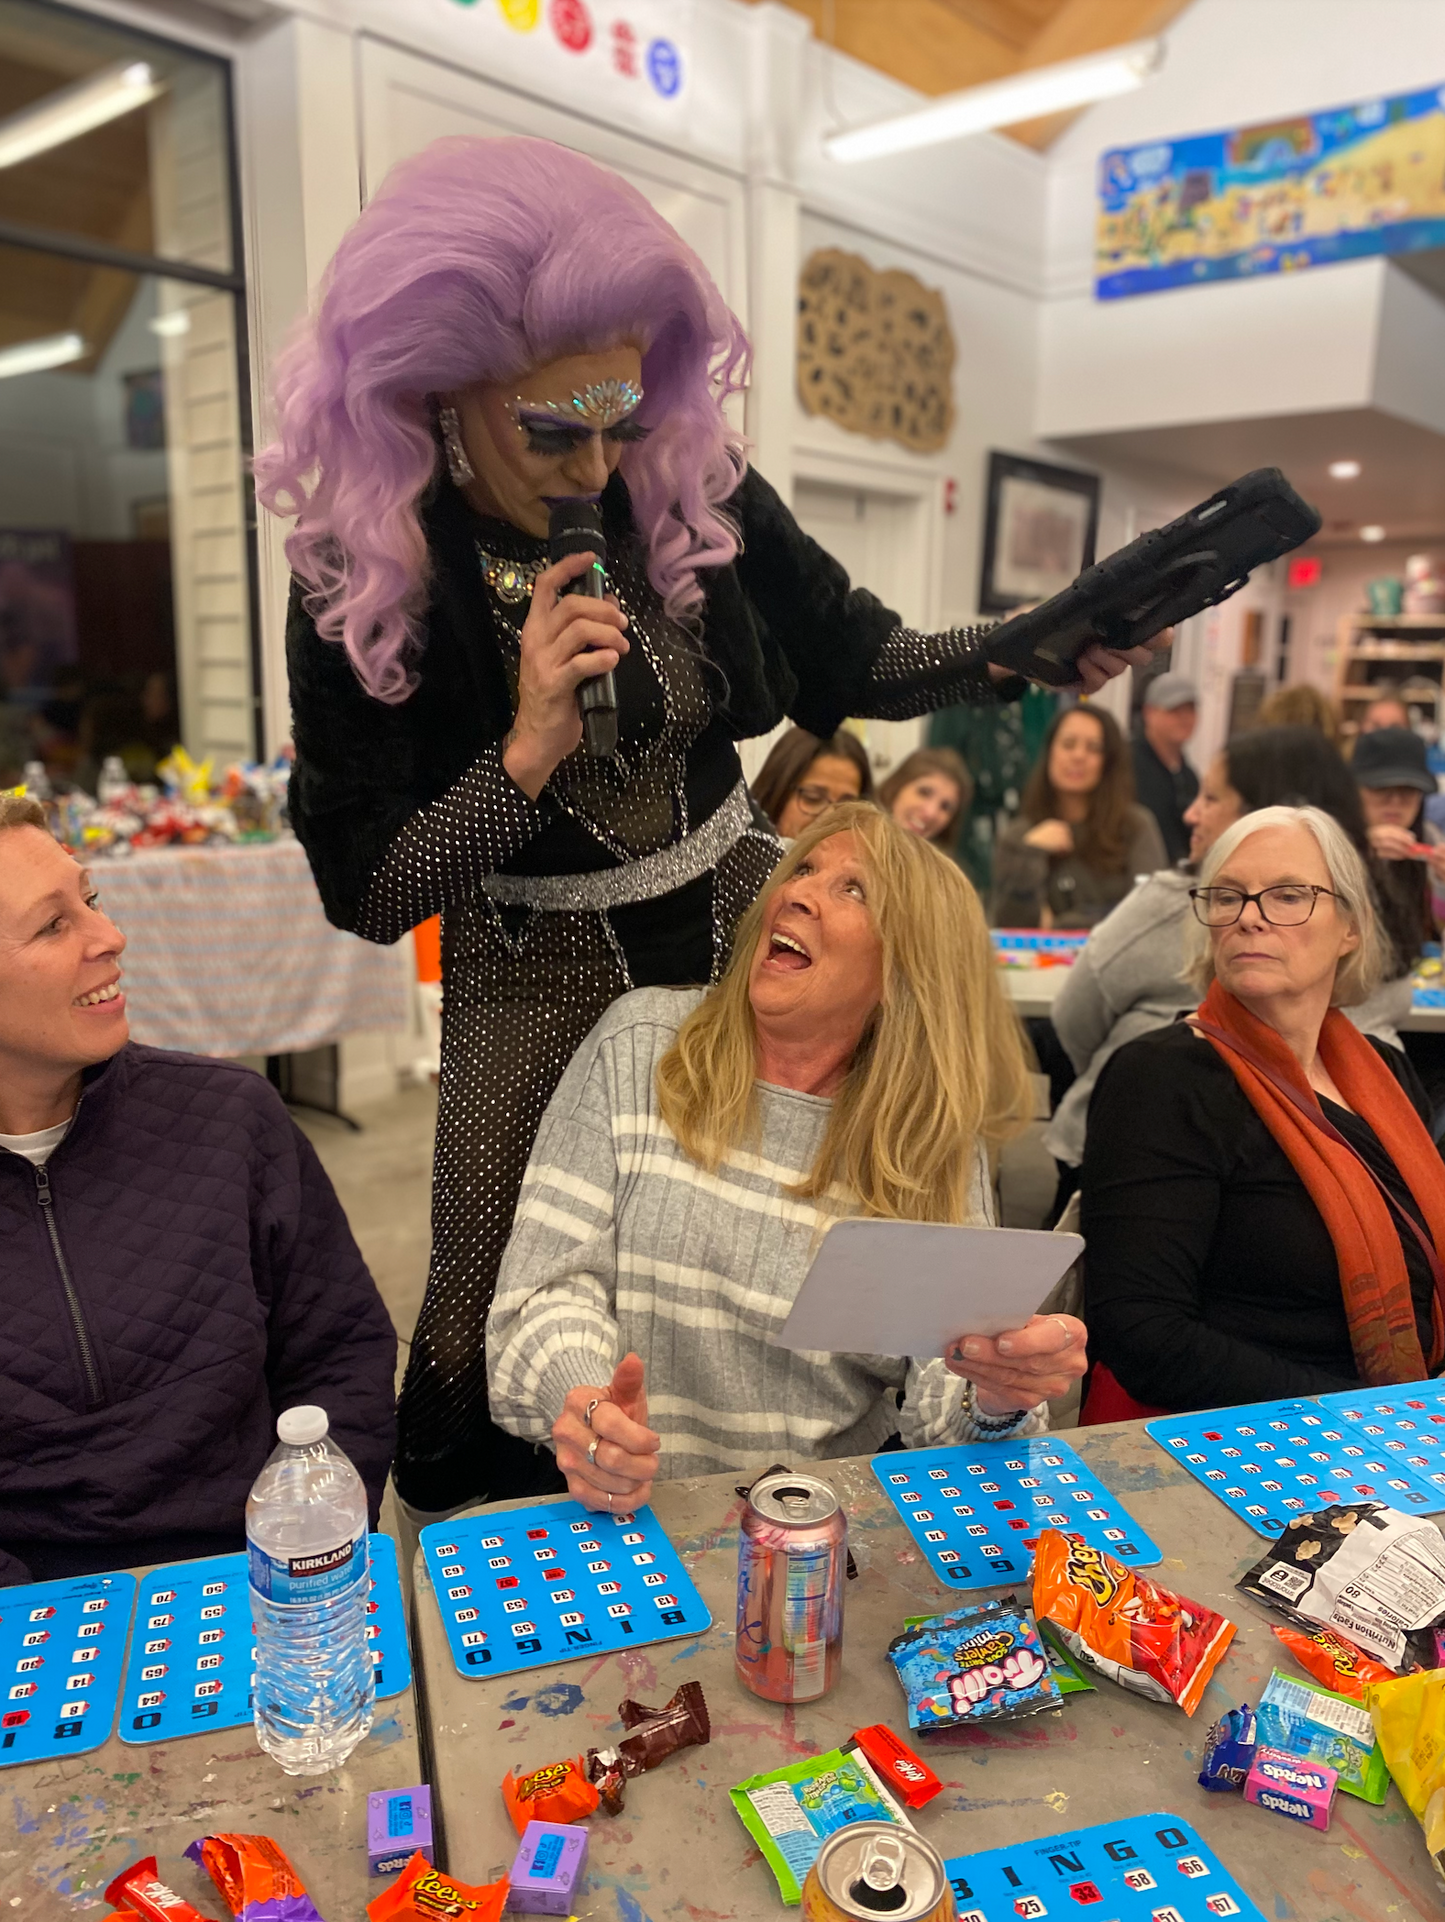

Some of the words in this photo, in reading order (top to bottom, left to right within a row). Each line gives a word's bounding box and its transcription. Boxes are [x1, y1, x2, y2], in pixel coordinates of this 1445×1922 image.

[892, 1476, 906, 1484] 69
[942, 1489, 958, 1497] 53
[982, 1484, 998, 1492] 35
[904, 1494, 918, 1502] 65
[956, 1507, 970, 1515] 46
[916, 1512, 929, 1521] 67
[528, 1530, 543, 1538] 33
[969, 1526, 984, 1535] 50
[929, 1532, 943, 1540] 74
[485, 1538, 498, 1547] 51
[580, 1542, 596, 1551] 26
[438, 1546, 453, 1555] 66
[536, 1550, 551, 1559] 44
[983, 1546, 999, 1555] 52
[1114, 1543, 1141, 1556] B
[292, 1544, 352, 1571] KIRKLAND
[941, 1552, 957, 1561] 64
[490, 1558, 506, 1567] 60
[592, 1562, 605, 1571] 27
[990, 1560, 1015, 1573] G
[444, 1566, 460, 1576] 63
[946, 1566, 973, 1580] O
[290, 1576, 329, 1591] purified
[331, 1564, 354, 1580] water
[648, 1575, 660, 1584] 12
[500, 1579, 514, 1588] 57
[601, 1584, 616, 1593] 16
[206, 1586, 223, 1595] 50
[451, 1588, 467, 1598] 68
[1345, 1586, 1361, 1599] 80
[156, 1594, 170, 1603] 70
[554, 1591, 570, 1601] 34
[658, 1596, 672, 1606] 13
[89, 1603, 103, 1611] 15
[506, 1600, 523, 1611] 53
[611, 1605, 626, 1615] 21
[204, 1608, 221, 1618] 55
[458, 1610, 474, 1621] 69
[660, 1610, 687, 1626] B
[1378, 1606, 1410, 1630] Calories
[153, 1618, 168, 1627] 75
[564, 1614, 578, 1624] 41
[1332, 1613, 1355, 1630] Facts
[84, 1627, 98, 1636] 10
[514, 1624, 532, 1634] 55
[28, 1635, 44, 1645] 20
[202, 1632, 219, 1642] 48
[467, 1634, 481, 1645] 71
[564, 1628, 593, 1645] N
[1355, 1623, 1396, 1650] Nutrition
[148, 1642, 166, 1652] 62
[516, 1638, 543, 1655] G
[954, 1632, 1015, 1662] Crawlers
[466, 1649, 492, 1666] O
[987, 1648, 1008, 1663] SOUR
[22, 1661, 38, 1671] 30
[200, 1658, 218, 1668] 58
[146, 1668, 163, 1678] 65
[72, 1678, 87, 1688] 14
[951, 1650, 1044, 1714] Trolli
[15, 1688, 30, 1698] 19
[198, 1684, 216, 1695] 49
[142, 1694, 160, 1706] 64
[8, 1715, 23, 1726] 18
[54, 1721, 83, 1739] B
[1260, 1749, 1302, 1764] strawberry
[1034, 1840, 1082, 1857] FINGER-TIP
[1048, 1851, 1086, 1876] N
[1103, 1839, 1139, 1862] G
[1155, 1828, 1189, 1849] O
[1020, 1900, 1041, 1916] 25
[1074, 1886, 1097, 1901] 33
[1130, 1873, 1151, 1888] 58
[1182, 1860, 1204, 1875] 66
[1213, 1898, 1233, 1912] 67
